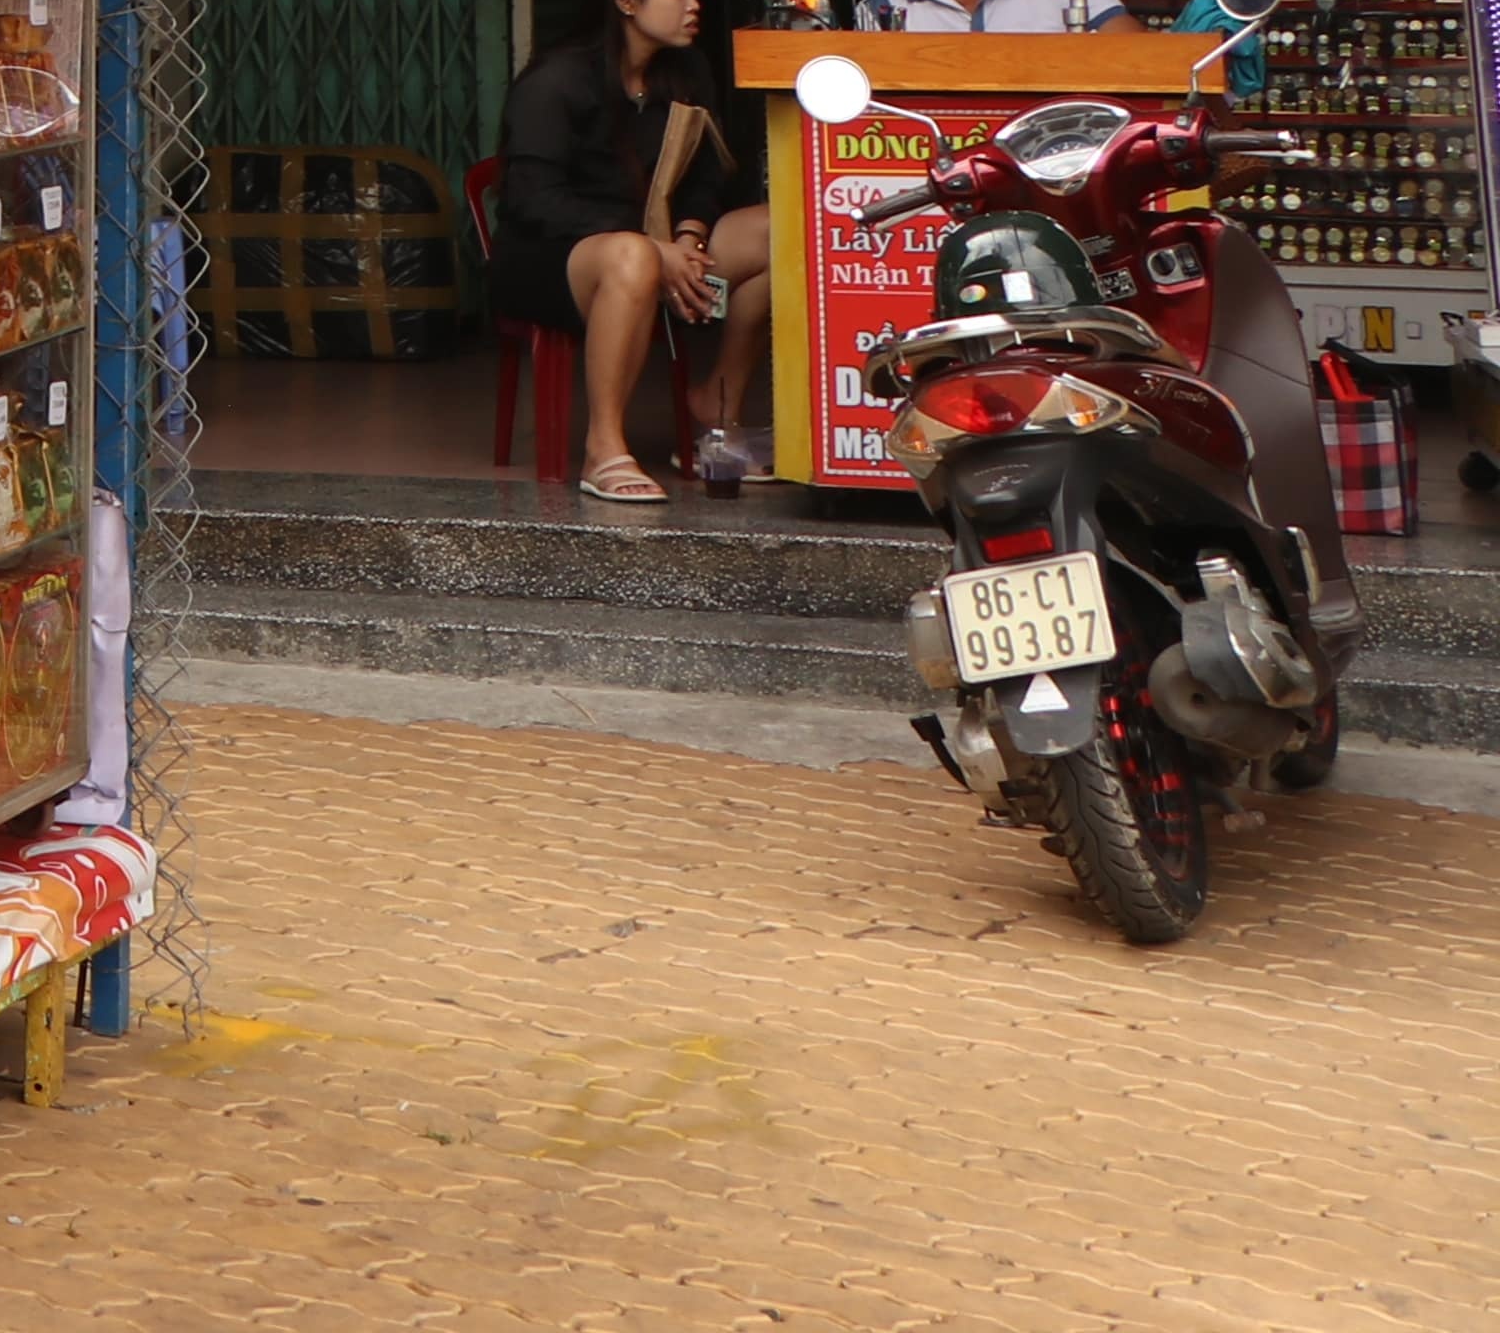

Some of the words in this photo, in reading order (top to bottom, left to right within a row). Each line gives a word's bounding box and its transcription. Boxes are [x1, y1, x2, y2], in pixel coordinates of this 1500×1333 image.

[835, 120, 932, 162] ĐỒNG
[829, 261, 912, 292] Nhận
[971, 564, 1077, 622] 86-C1
[965, 608, 1098, 673] 993.87
